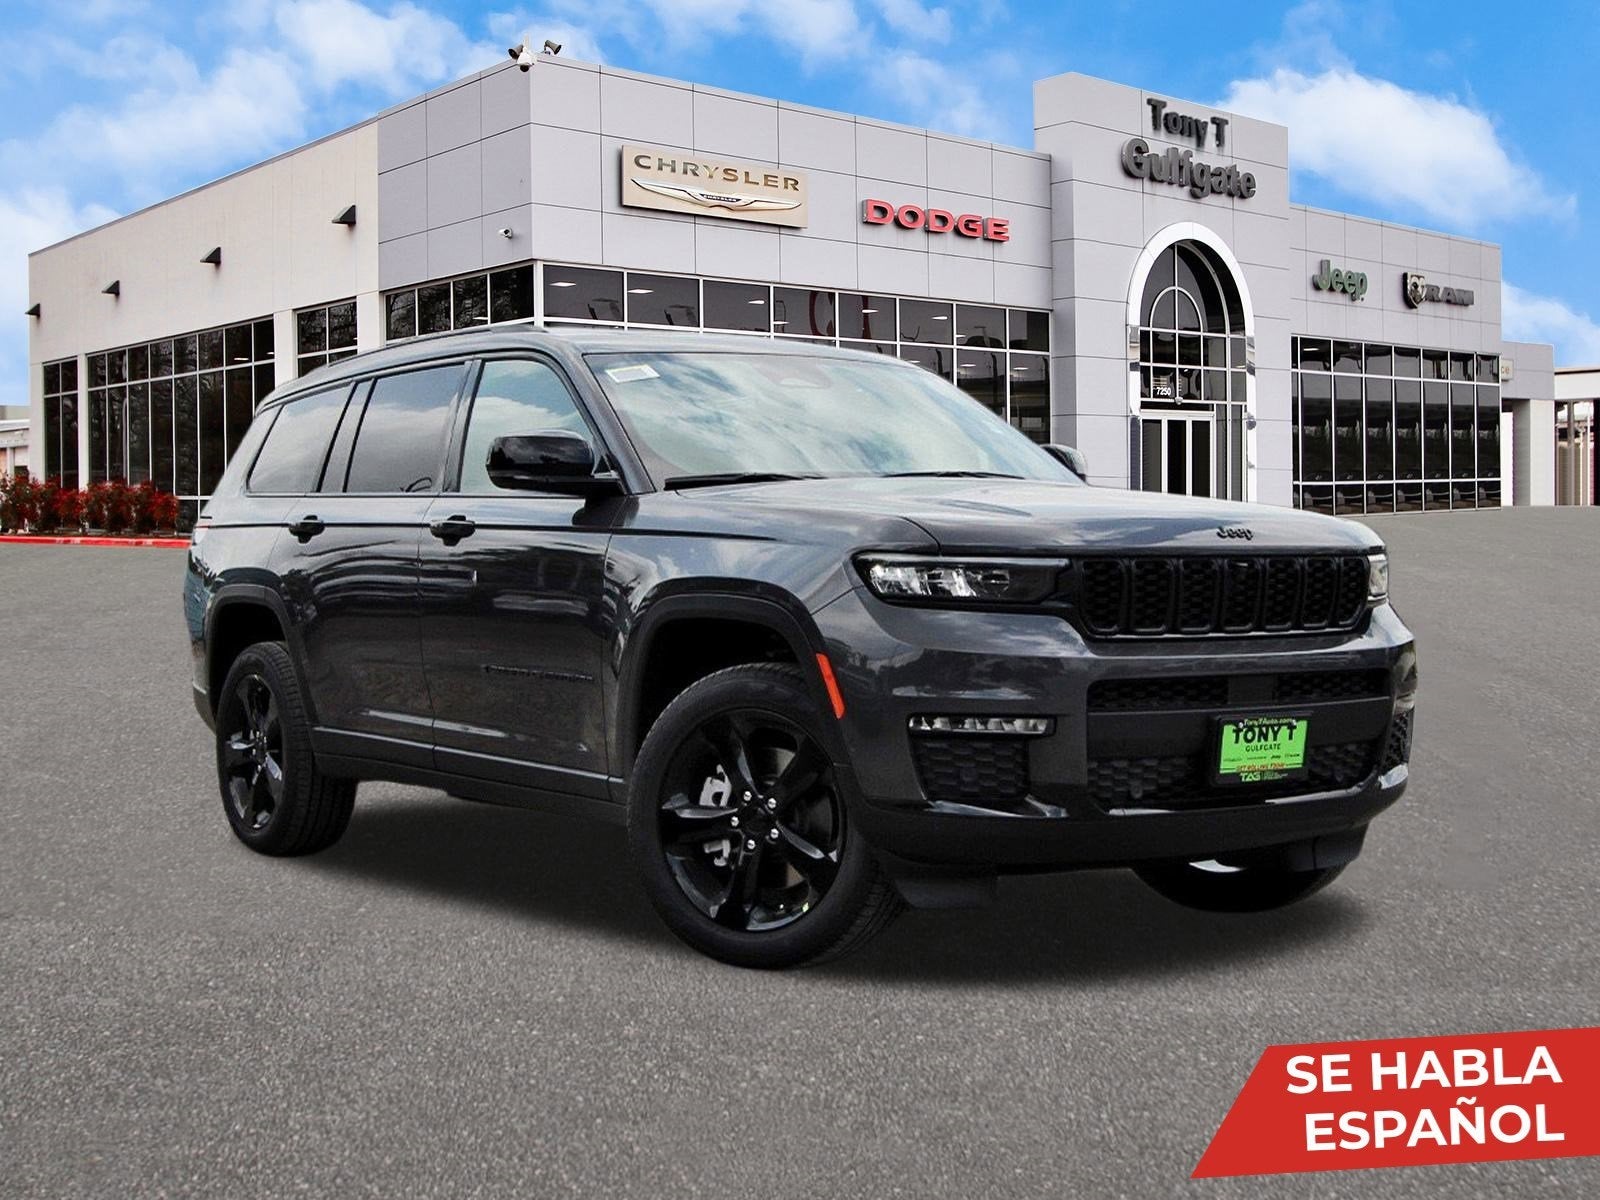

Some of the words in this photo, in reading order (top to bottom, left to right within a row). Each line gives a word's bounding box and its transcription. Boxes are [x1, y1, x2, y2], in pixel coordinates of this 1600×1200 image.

[1146, 98, 1208, 148] Tony
[1210, 116, 1229, 148] T
[634, 154, 800, 192] CHRYSLER
[1121, 138, 1256, 199] Gulfgate
[862, 199, 1010, 242] DODGE
[1312, 259, 1368, 302] Jeep
[1425, 284, 1474, 306] RAM
[1216, 526, 1254, 541] Jeep
[1232, 724, 1281, 744] TONY
[1287, 721, 1297, 741] T
